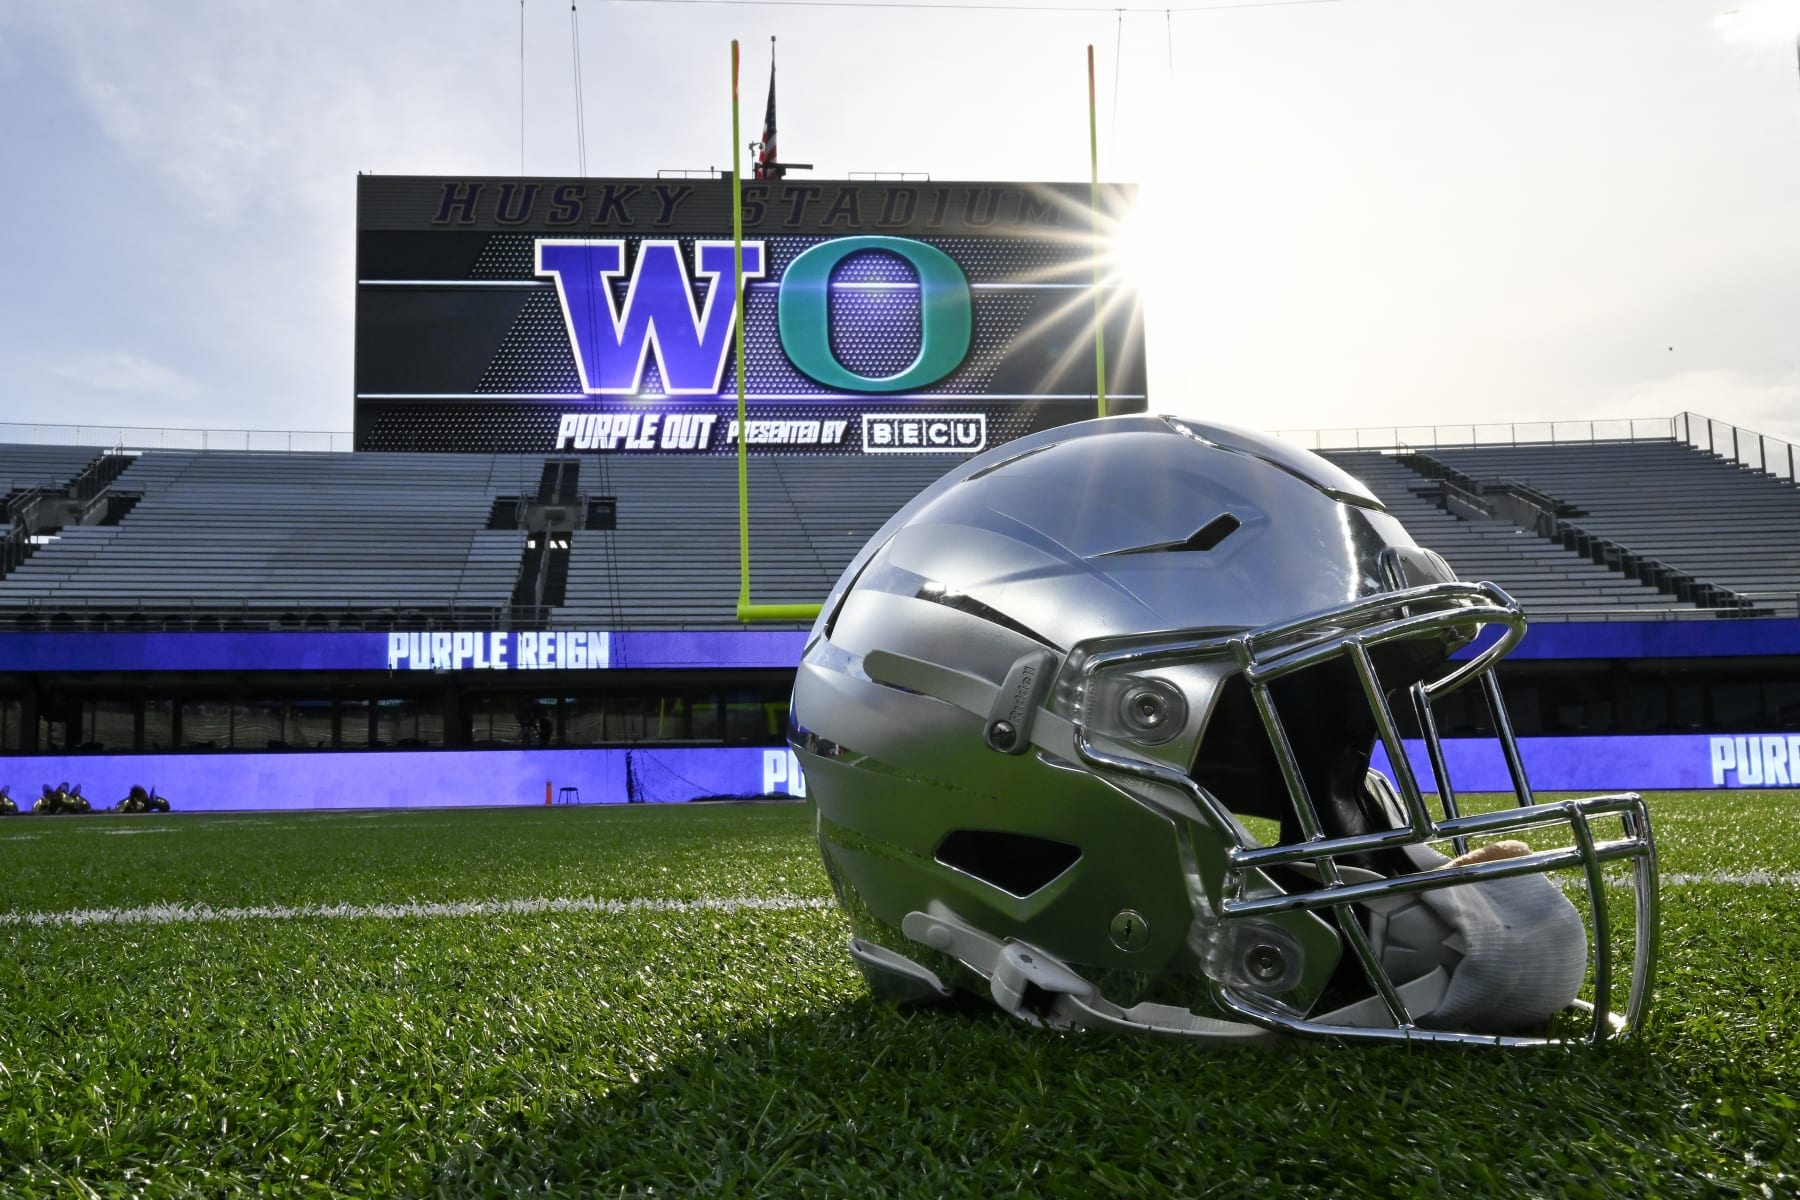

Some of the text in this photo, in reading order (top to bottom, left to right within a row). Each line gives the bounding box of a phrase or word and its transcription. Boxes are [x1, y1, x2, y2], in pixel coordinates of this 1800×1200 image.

[431, 183, 1063, 228] HUSKY STADIUM
[534, 239, 766, 395] W
[778, 235, 972, 391] O
[556, 413, 848, 449] PURPLE OUT PRESENTED BY
[873, 423, 977, 444] BECU
[388, 632, 609, 670] PURPLE REIGN
